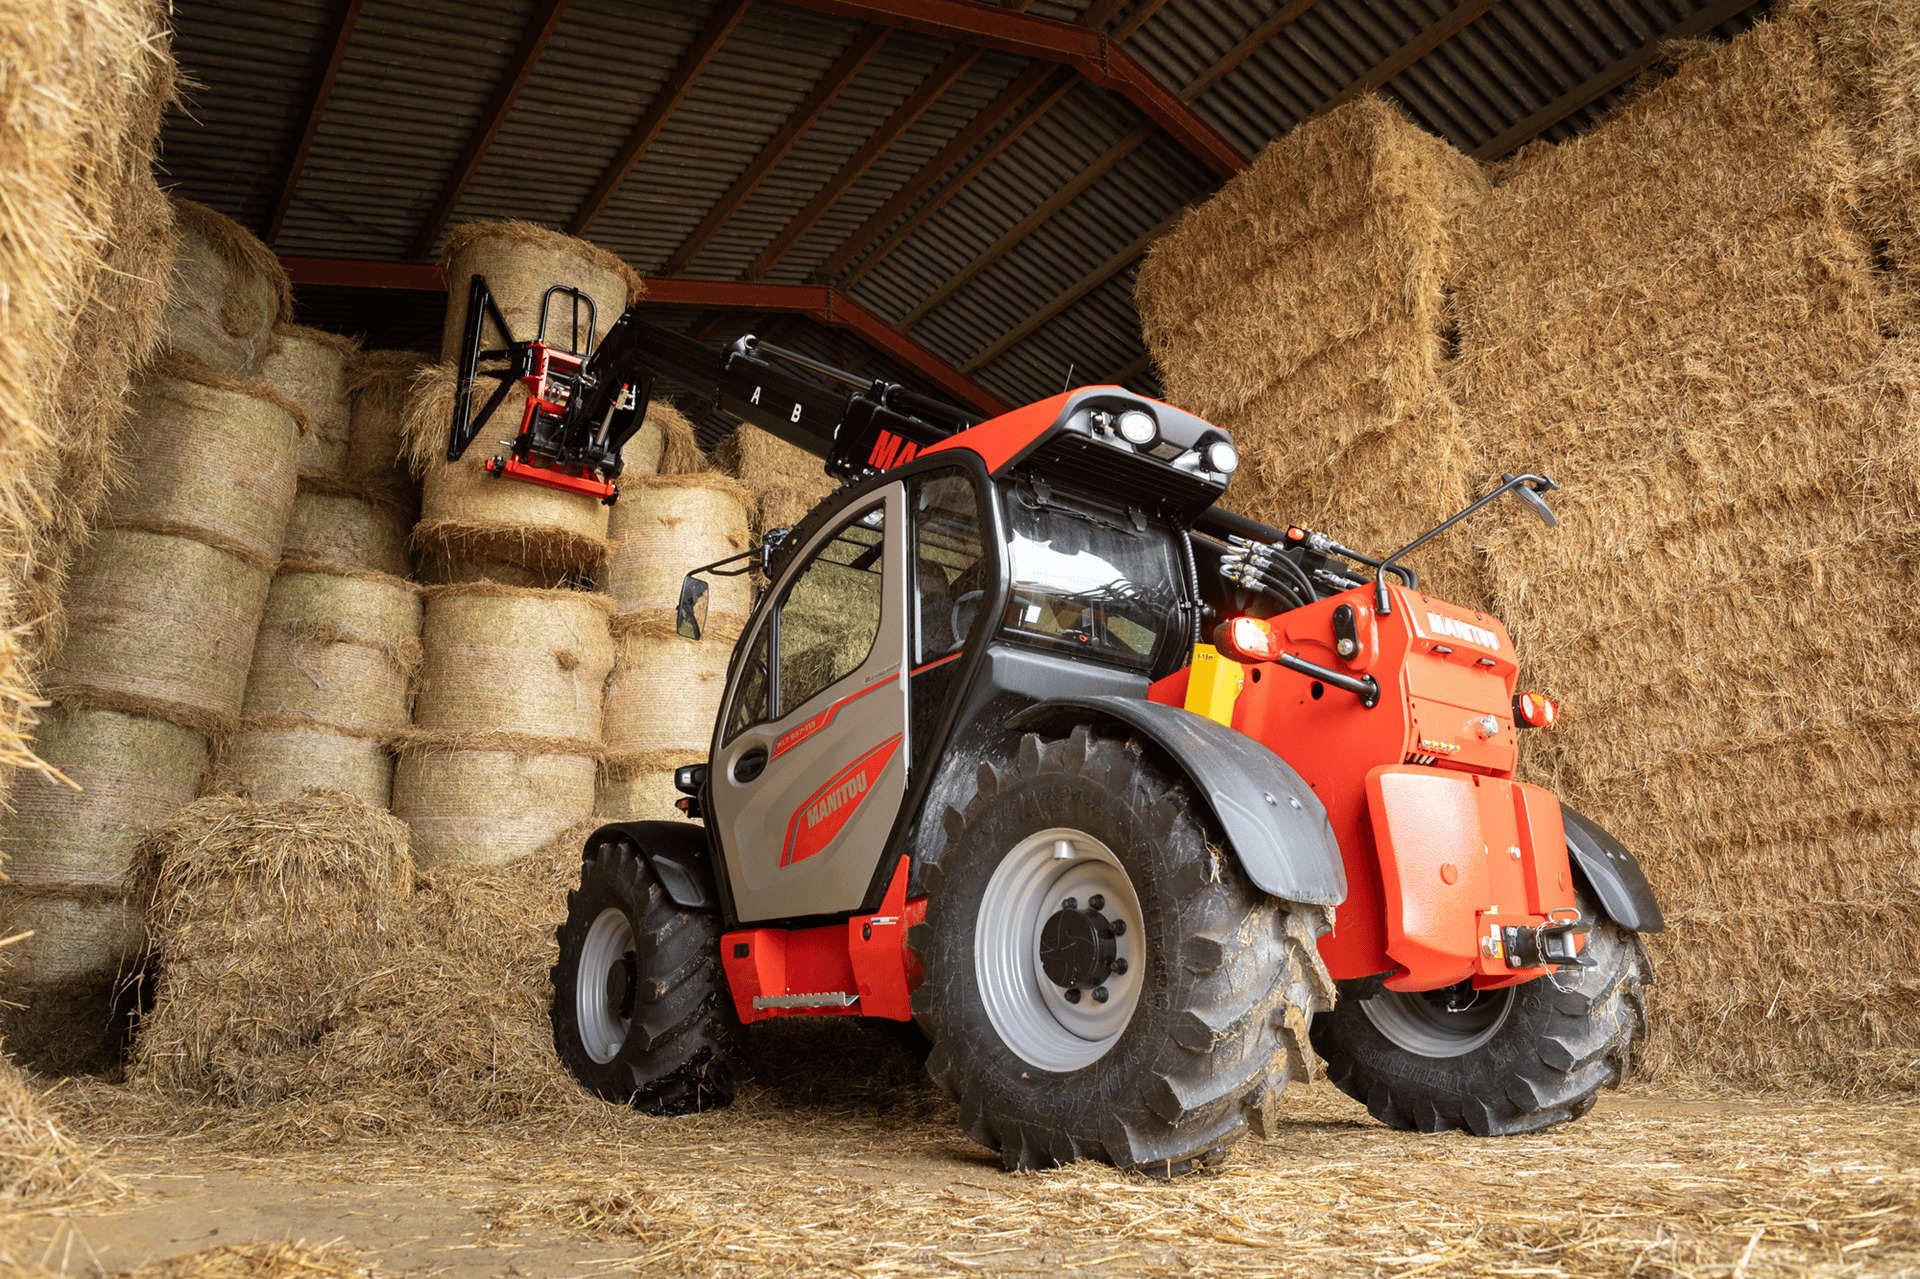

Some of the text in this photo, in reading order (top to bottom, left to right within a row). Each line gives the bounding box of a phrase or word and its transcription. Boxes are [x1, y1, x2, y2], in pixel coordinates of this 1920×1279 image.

[750, 386, 802, 423] A B
[1427, 611, 1500, 651] MANITOU
[807, 770, 867, 830] MANITOU
